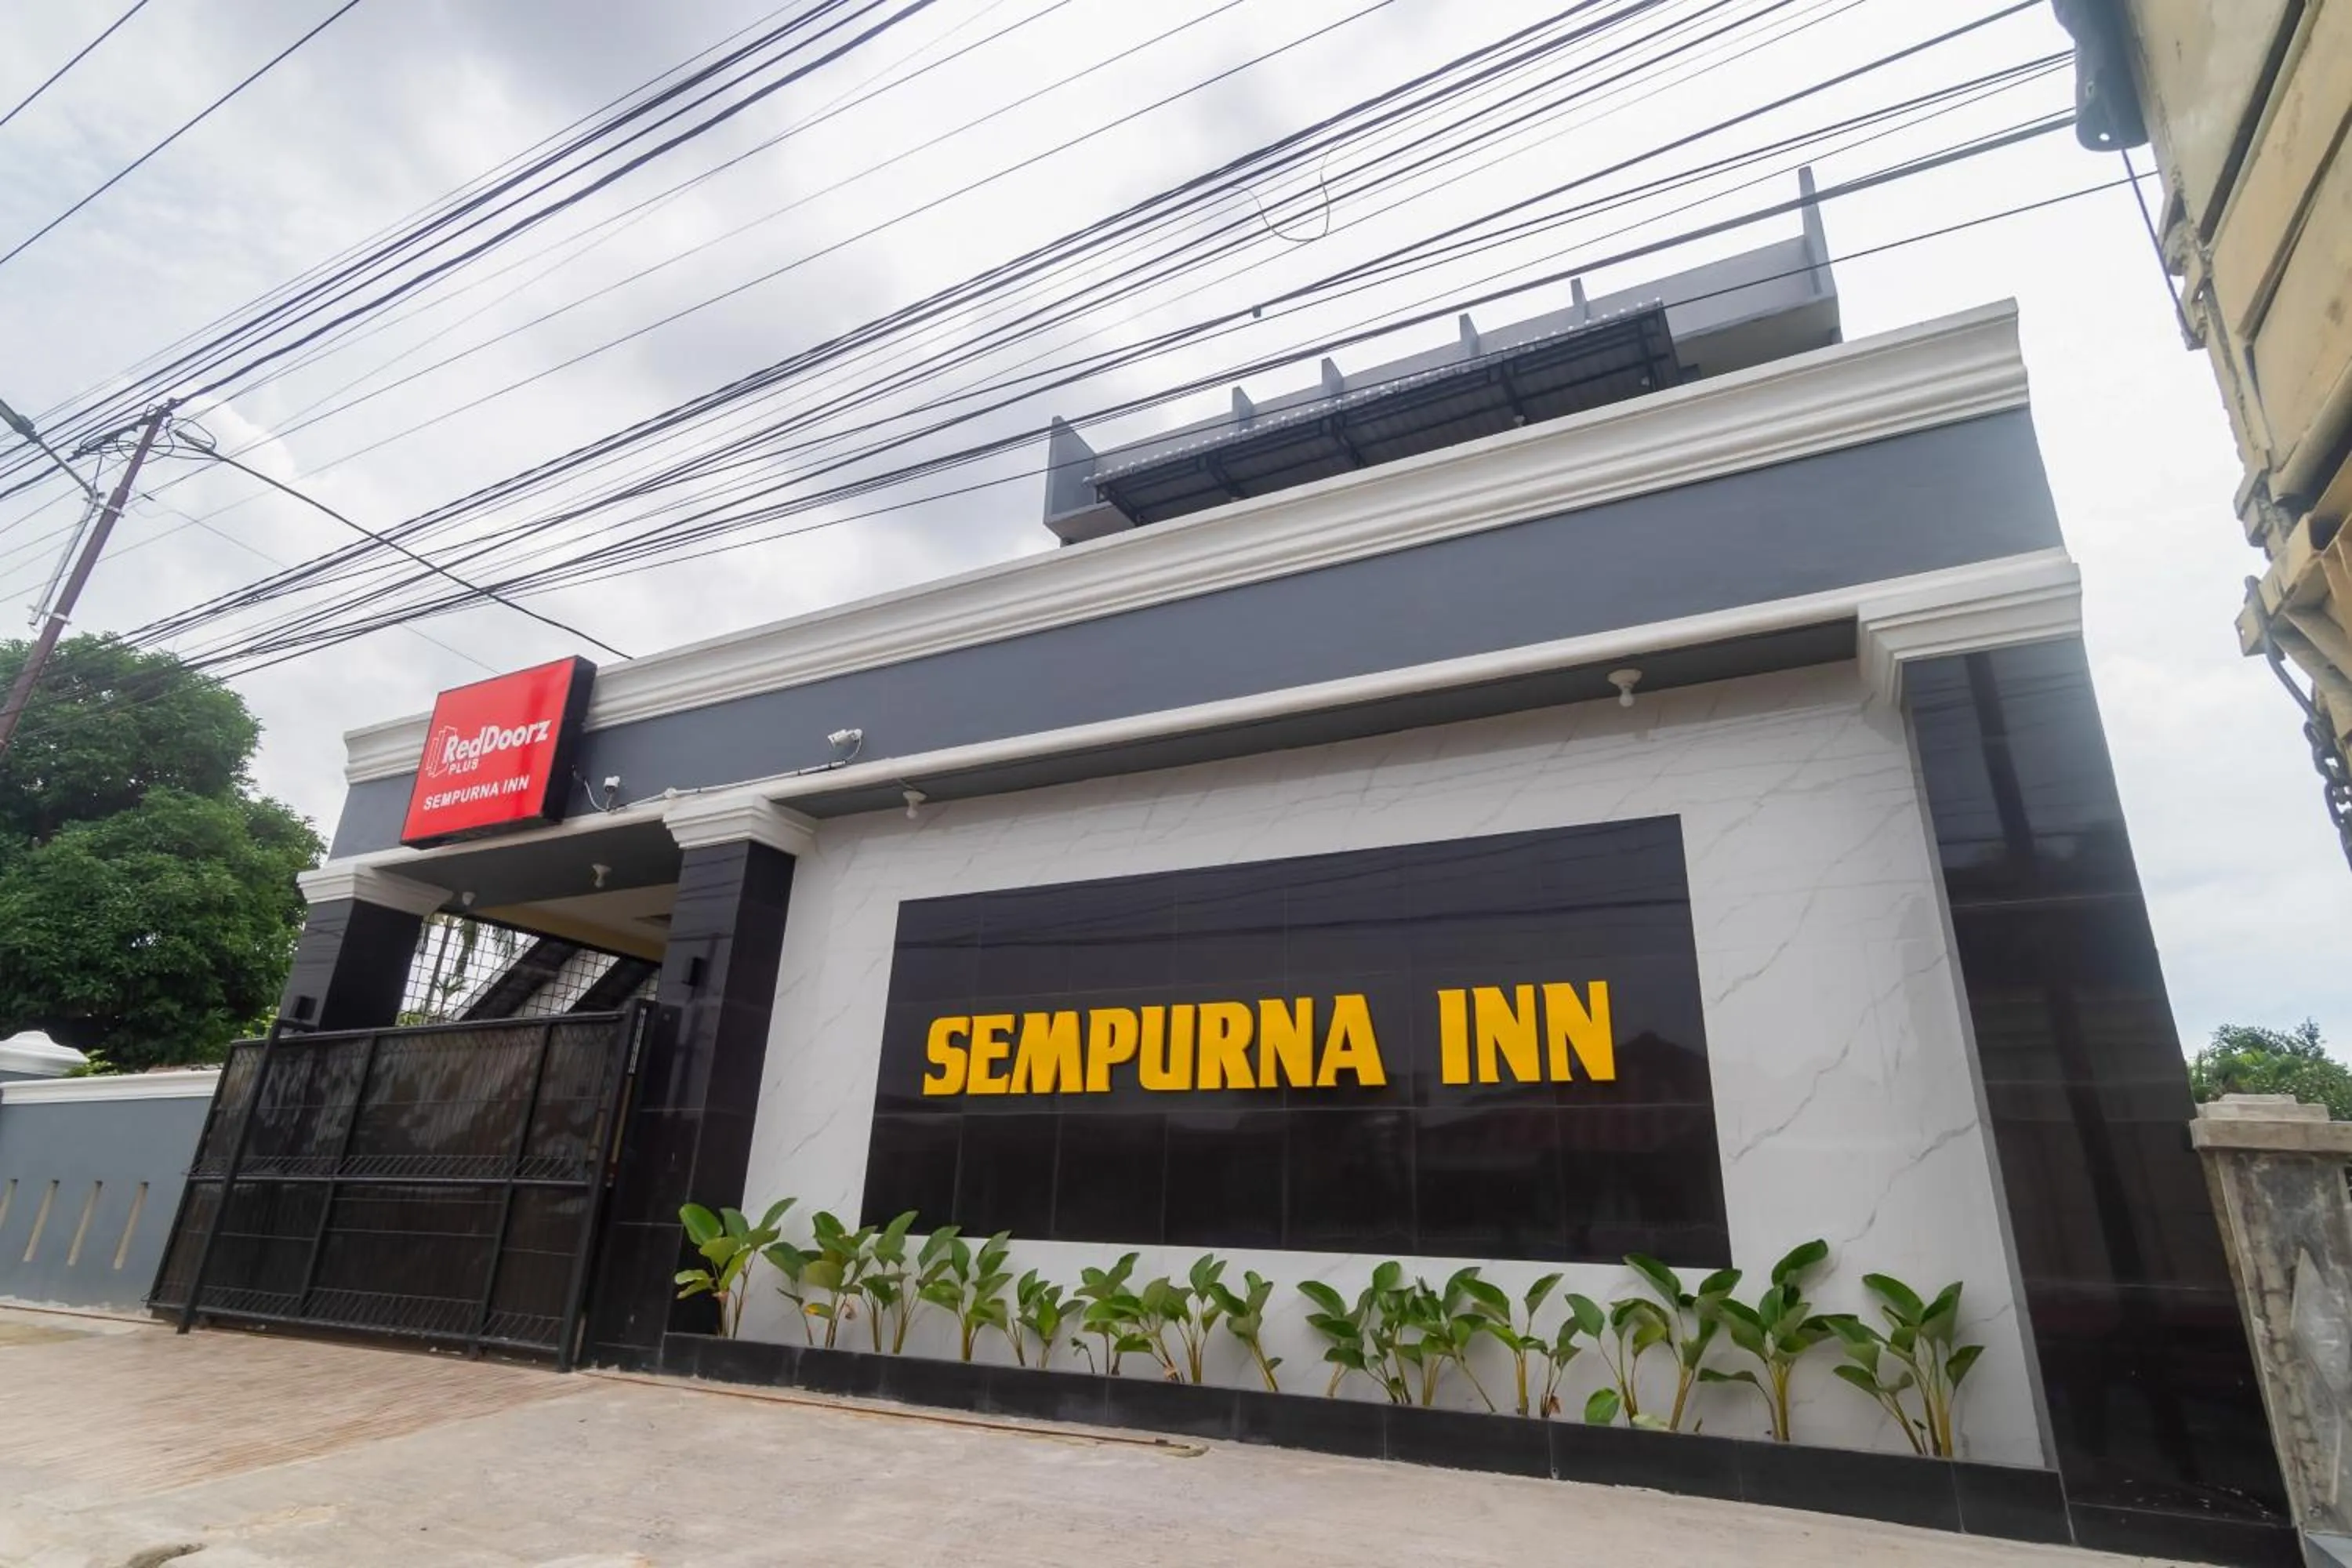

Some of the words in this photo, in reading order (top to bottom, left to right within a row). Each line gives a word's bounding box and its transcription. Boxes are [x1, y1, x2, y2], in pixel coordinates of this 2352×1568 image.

[442, 719, 552, 764] RedDoorz
[448, 758, 479, 775] PLUS
[423, 782, 499, 811] SEMPURNA
[502, 775, 530, 792] INN
[923, 993, 1388, 1095] SEMPURNA
[1437, 980, 1616, 1084] INN
